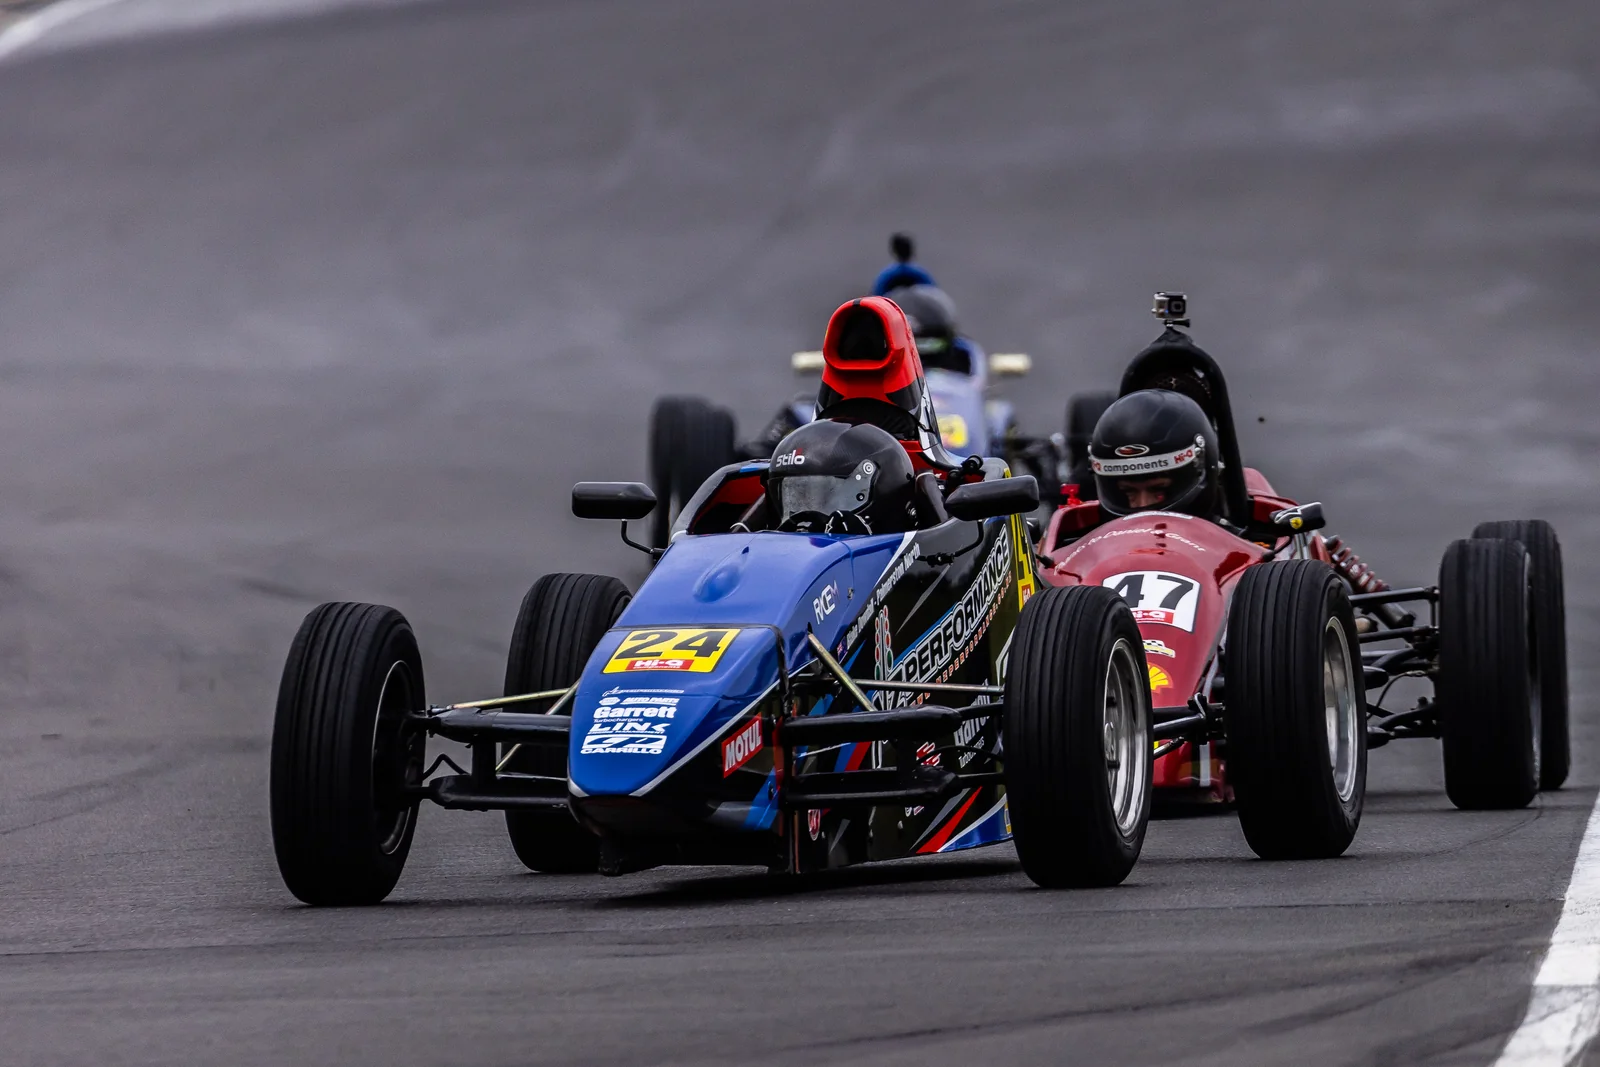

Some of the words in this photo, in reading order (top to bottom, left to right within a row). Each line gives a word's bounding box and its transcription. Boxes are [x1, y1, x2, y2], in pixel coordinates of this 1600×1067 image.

[776, 449, 805, 467] Stilo
[1103, 459, 1169, 473] components
[1113, 574, 1194, 610] 47
[614, 630, 721, 660] 24
[634, 659, 684, 667] Hi-Q
[593, 706, 677, 719] Garrett
[580, 747, 663, 755] CARRILLO
[725, 720, 761, 772] MOTUL
